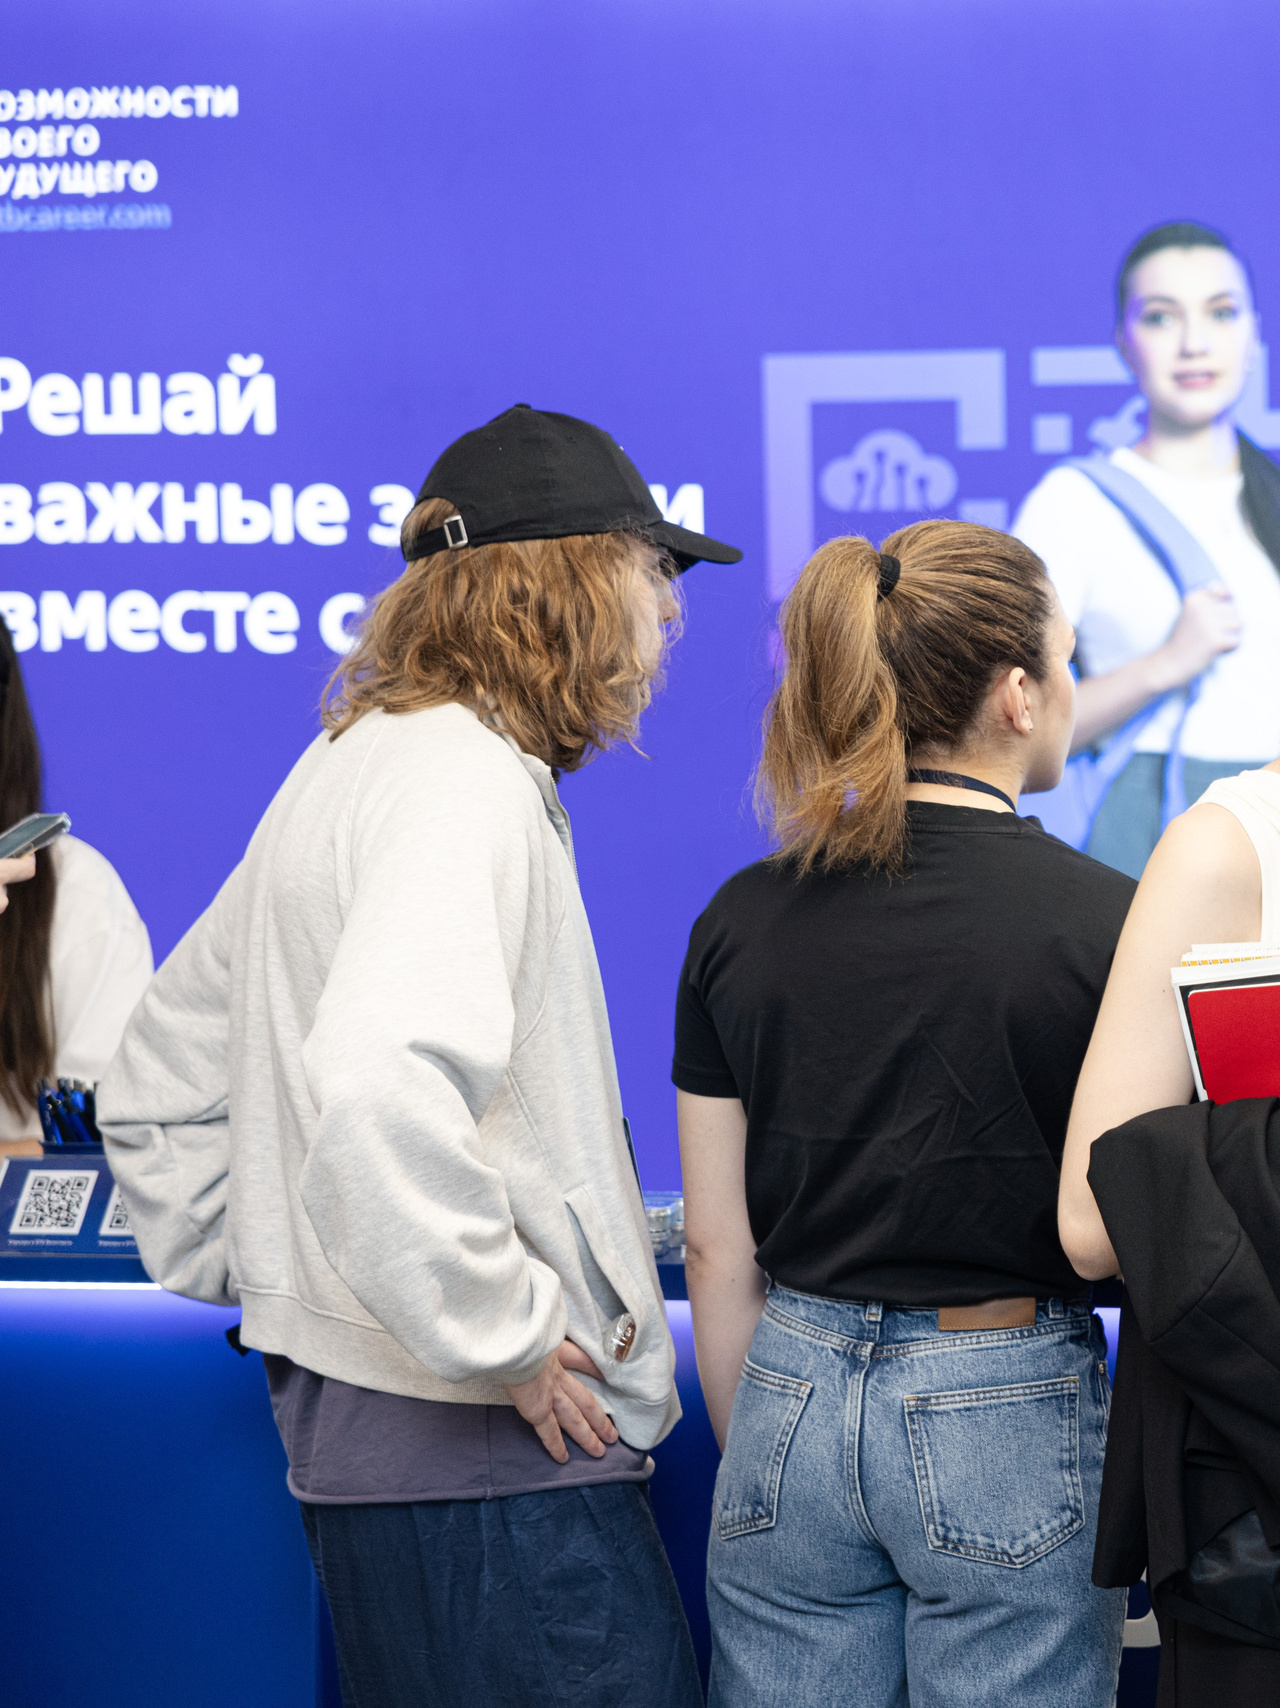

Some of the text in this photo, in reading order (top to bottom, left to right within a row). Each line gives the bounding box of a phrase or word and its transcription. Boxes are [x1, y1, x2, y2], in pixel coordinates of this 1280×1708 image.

[0, 84, 240, 123] ОЗМОЖНОСТИ
[0, 159, 159, 200] УДУЩЕГО
[0, 353, 278, 437] Решай
[0, 481, 351, 546] важные
[0, 589, 301, 654] вместе
